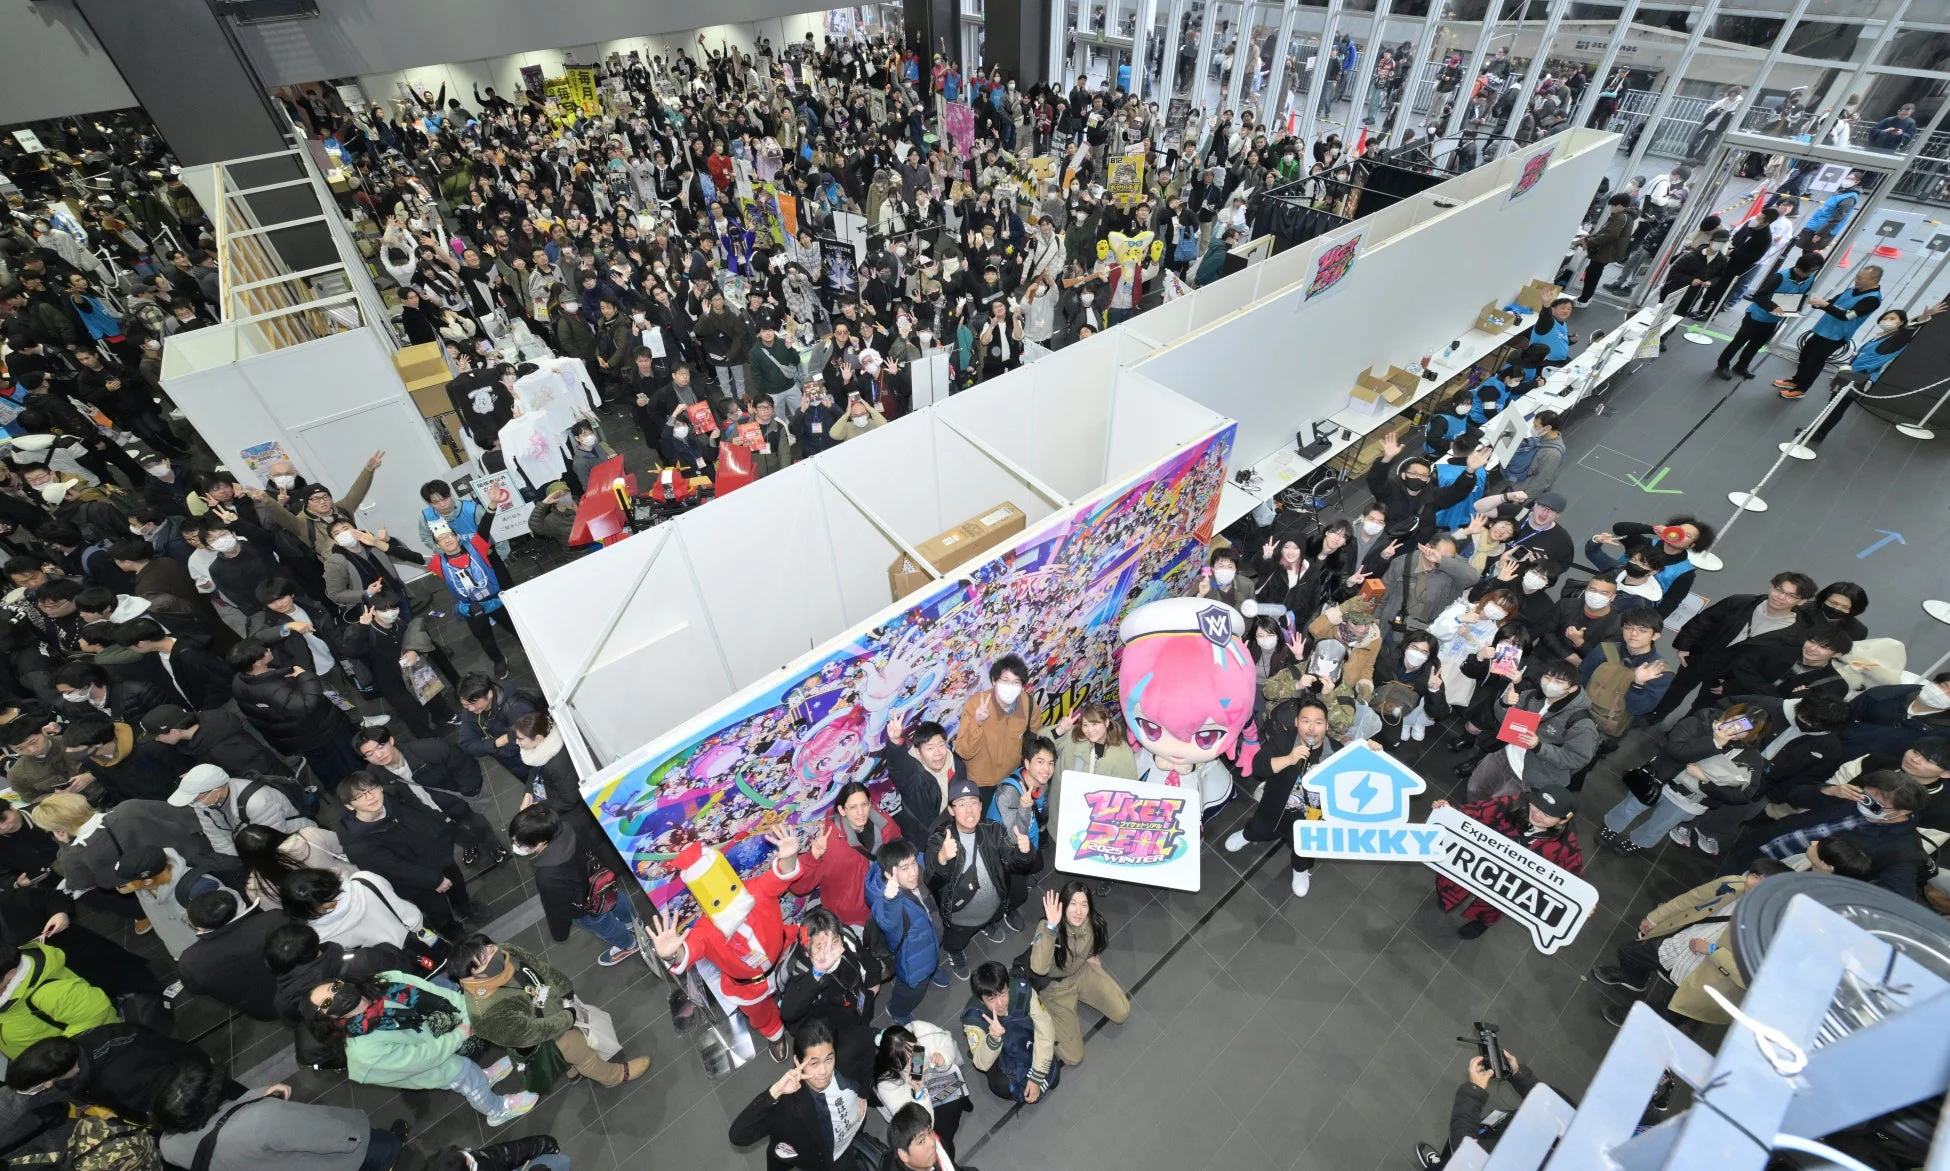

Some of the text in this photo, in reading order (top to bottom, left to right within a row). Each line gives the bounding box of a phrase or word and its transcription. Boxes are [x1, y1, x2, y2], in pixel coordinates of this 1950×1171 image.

[1087, 842, 1124, 855] 2025
[1299, 826, 1440, 856] HIKKY
[1103, 853, 1166, 865] WINTER
[1460, 820, 1566, 887] Experience in
